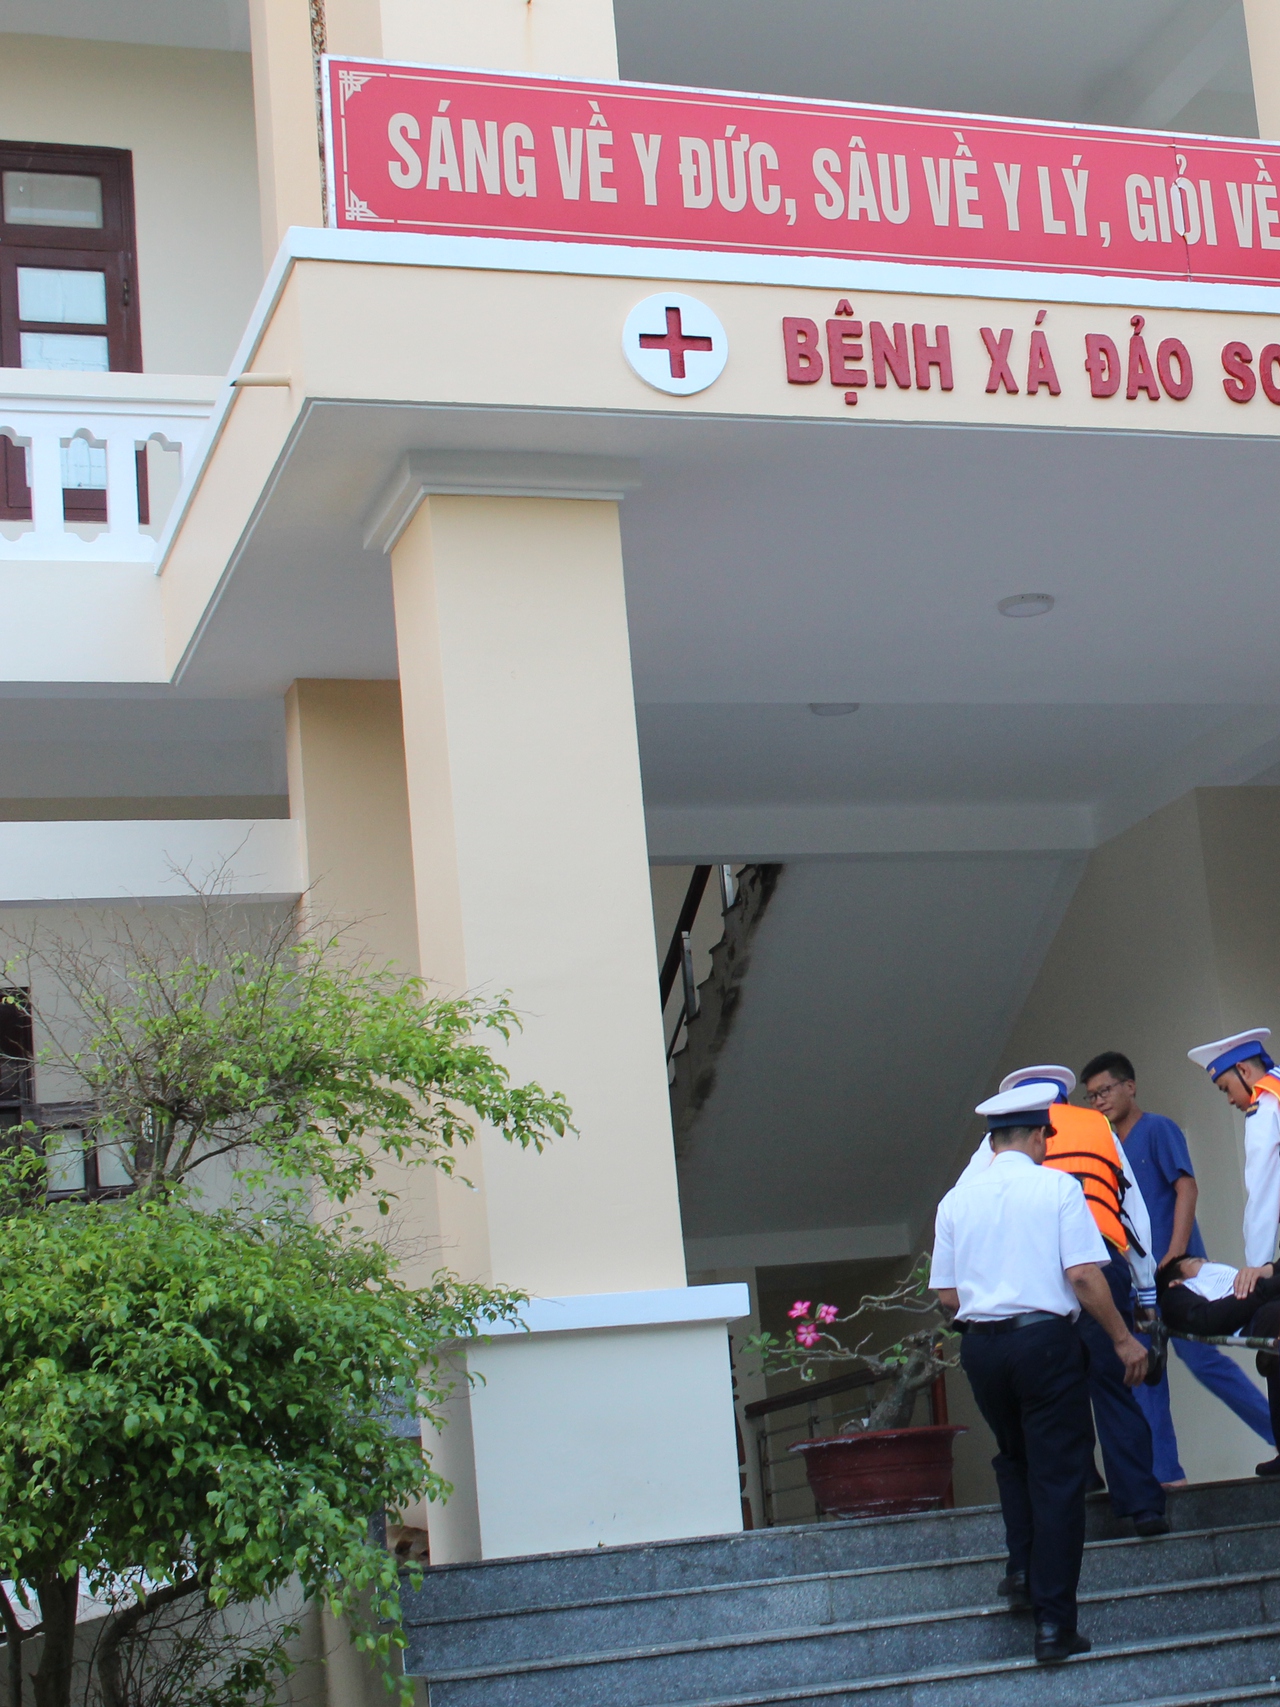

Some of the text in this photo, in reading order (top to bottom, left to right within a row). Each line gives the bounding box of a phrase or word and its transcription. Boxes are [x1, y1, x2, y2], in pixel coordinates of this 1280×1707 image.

[388, 100, 537, 198] SÁNG
[552, 99, 617, 203] VỀ
[631, 132, 662, 206] Y
[679, 124, 797, 226] ĐỨC,
[812, 135, 910, 225] SÂU
[922, 131, 984, 229] VỀ
[993, 161, 1021, 231] Y
[1125, 153, 1218, 246] GIỎI
[782, 299, 954, 405] BỆNH
[980, 310, 1061, 396] XÁ
[1084, 315, 1193, 401] ĐẢO
